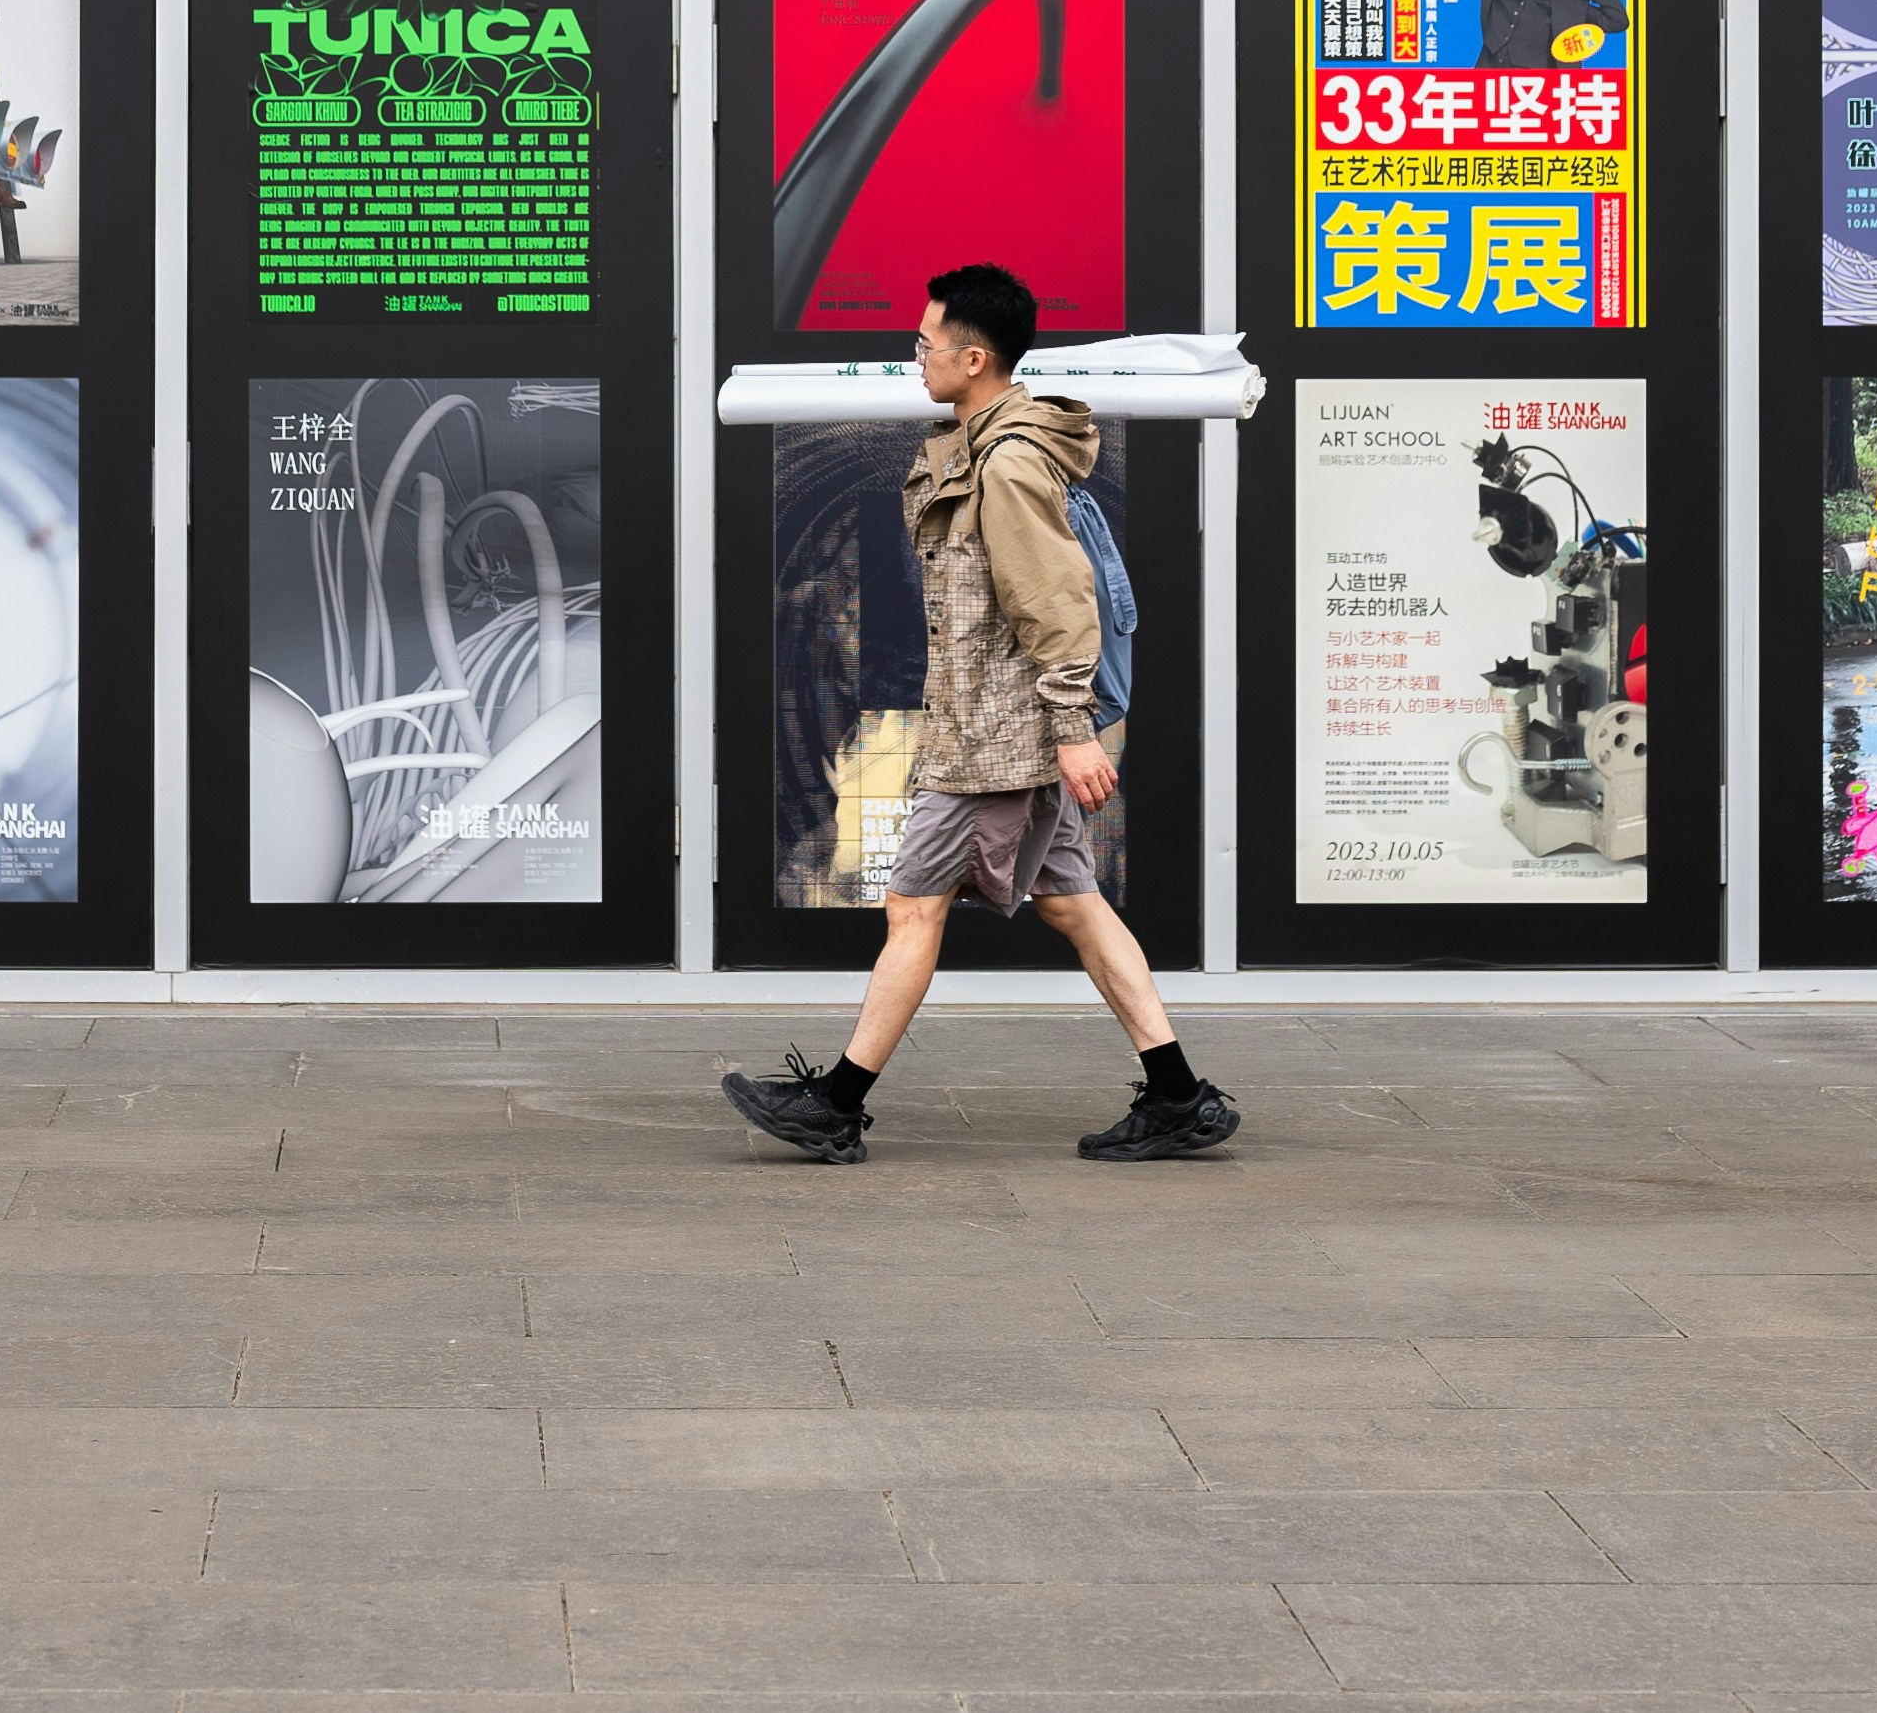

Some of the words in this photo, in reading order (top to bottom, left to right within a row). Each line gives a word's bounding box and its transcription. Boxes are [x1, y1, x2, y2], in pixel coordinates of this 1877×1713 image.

[253, 8, 591, 55] TUNICA
[1563, 33, 1584, 56] 新
[394, 102, 414, 121] TEA
[1321, 75, 1620, 144] 33年坚持
[1322, 155, 1620, 187] 在艺术行业用原装国产经验
[1322, 199, 1587, 315] 策展
[1320, 405, 1391, 421] LIJUAN
[1484, 402, 1543, 430] 油罐
[1547, 402, 1601, 415] TANK
[1548, 415, 1626, 429] SHANGHAI
[270, 413, 355, 443] 王梓全
[1320, 431, 1358, 447] ART
[1364, 431, 1446, 447] SCHOOL
[270, 452, 327, 475] WANG
[270, 487, 356, 513] ZIQUAN
[1326, 553, 1387, 564] 互动工作坊
[1326, 573, 1408, 593] 人造世界
[1325, 597, 1449, 618] 死去的机器人
[1326, 630, 1441, 646] 与小艺术家一起
[1326, 653, 1408, 668] 拆解与构建
[1326, 675, 1441, 691] 让这个艺术装置
[1326, 697, 1507, 714] 集合所有人的思考与创造
[1326, 720, 1392, 736] 持续生长
[420, 803, 491, 839] 油罐
[495, 803, 560, 821] TANK
[495, 820, 590, 839] SHANGHAI
[1325, 841, 1444, 862] 2023.10.05
[1325, 868, 1405, 883] 12:00-13:00
